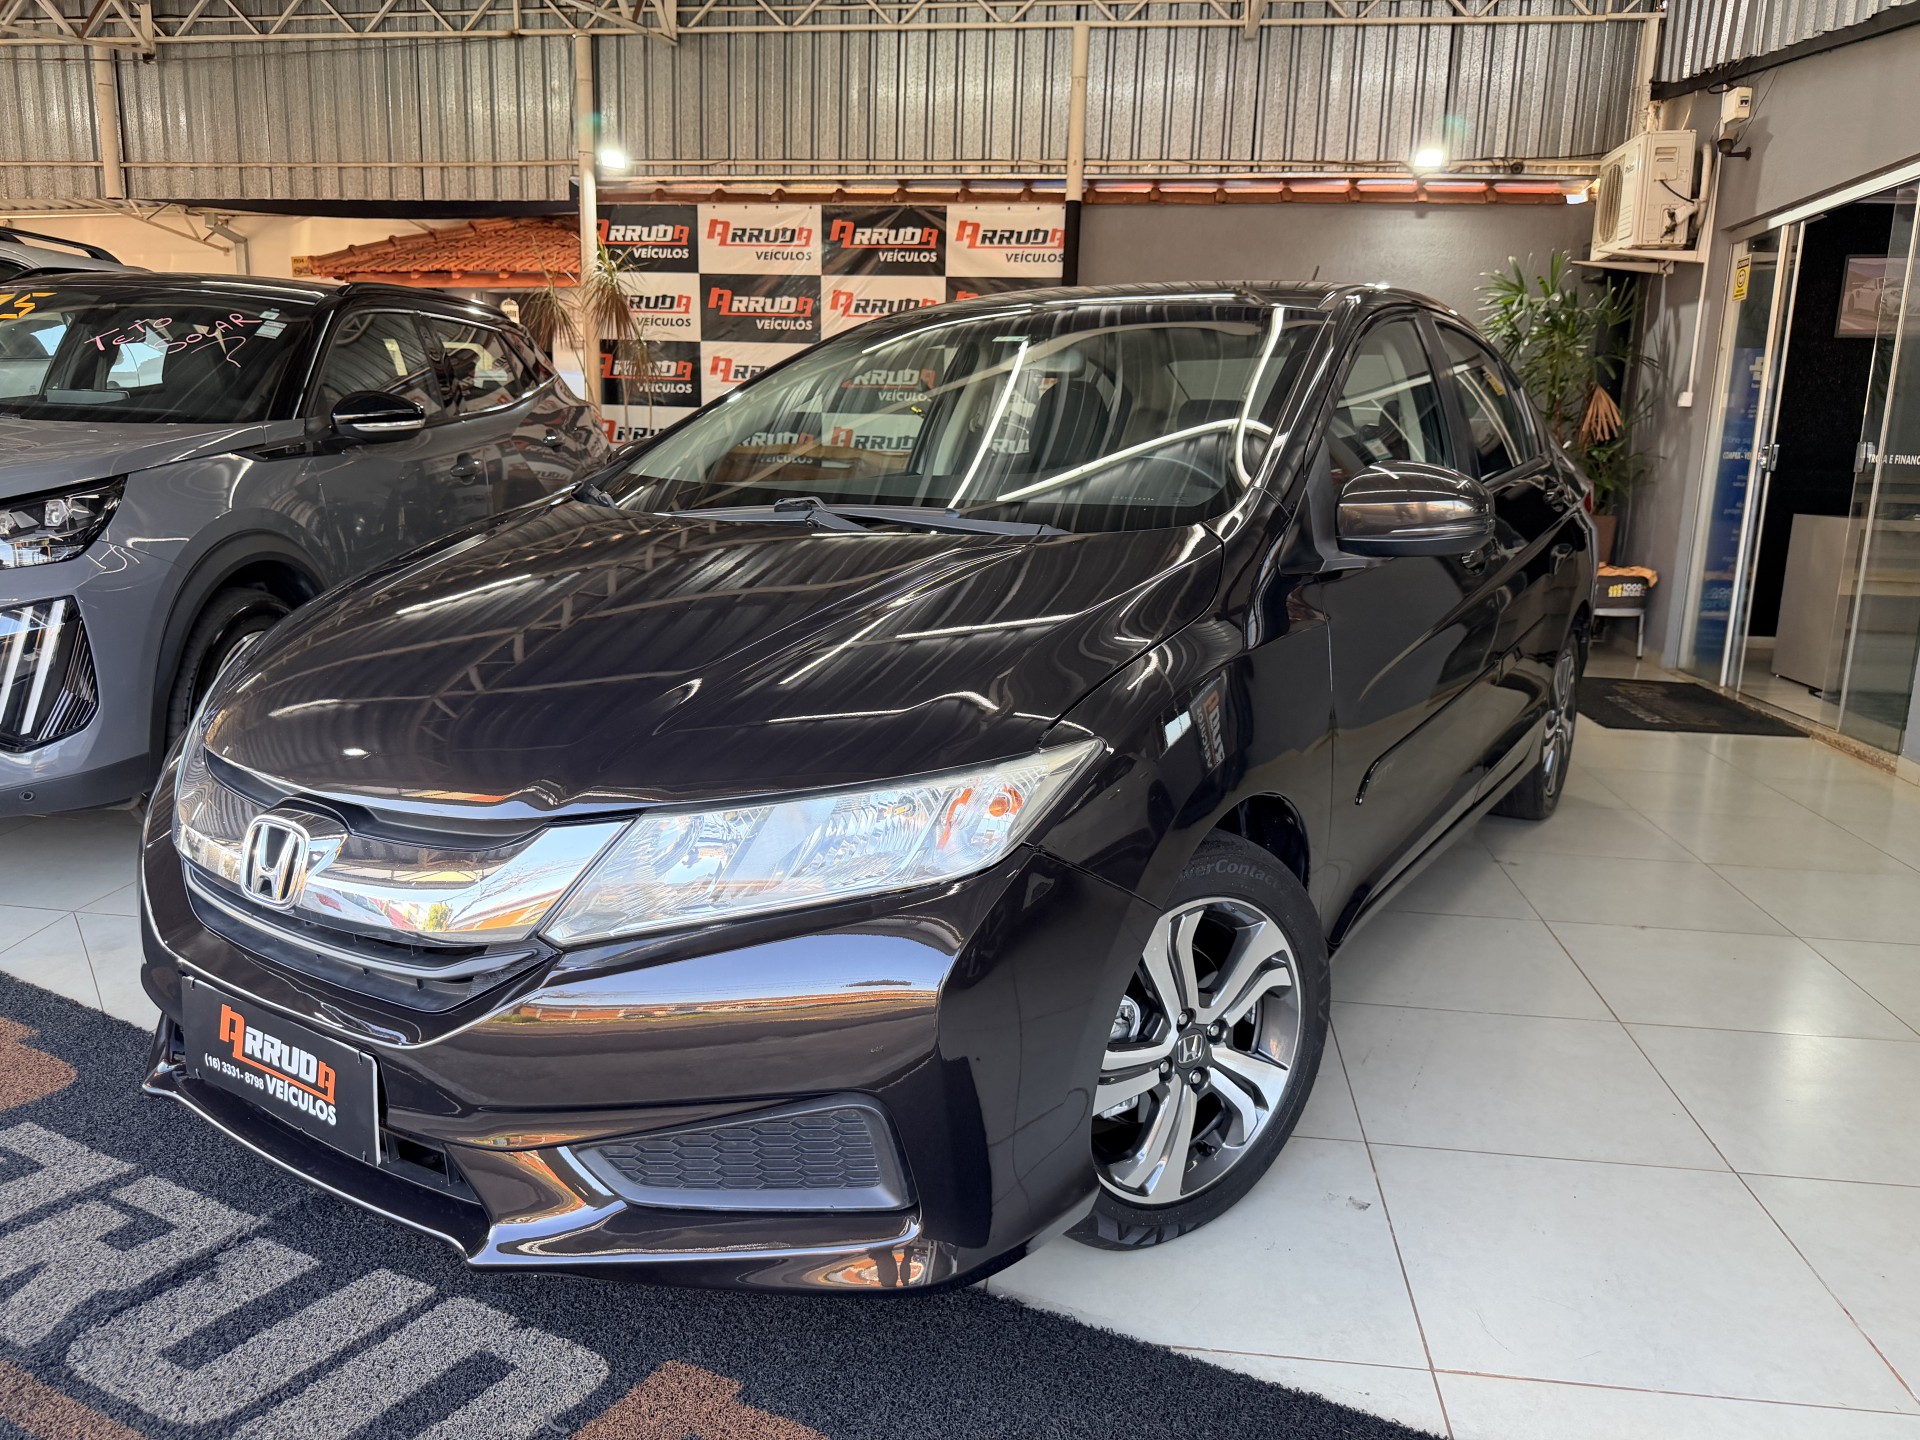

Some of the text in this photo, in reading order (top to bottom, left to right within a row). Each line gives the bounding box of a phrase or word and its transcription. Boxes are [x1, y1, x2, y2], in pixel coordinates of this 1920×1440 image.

[597, 218, 690, 246] ARRUDA
[707, 219, 813, 248] ARRUDA
[829, 219, 939, 249] ARRUDA
[955, 220, 1064, 249] ARRUDA
[633, 246, 689, 259] VEÍCULOS
[755, 249, 812, 262] VEÍCULOS
[878, 248, 937, 263] VEÍCULOS
[1005, 250, 1064, 263] VEÍCULOS
[625, 294, 691, 314] RUDA
[708, 287, 814, 317] ARRUDA
[636, 315, 691, 327] VEÍCULOS
[756, 316, 813, 331] VEÍCULOS
[84, 317, 173, 351] TETO
[154, 313, 262, 354] SOLAR
[710, 356, 766, 383] ARR
[841, 368, 936, 389] RRUDA
[878, 390, 932, 402] VEÍCULO
[602, 420, 664, 443] ARR
[739, 432, 814, 446] RUDA
[831, 426, 916, 450] ARRUD
[219, 1003, 336, 1105] ARRUDA
[204, 1053, 265, 1090] (16) 3331-8798
[265, 1073, 337, 1126] VEÍCULOS
